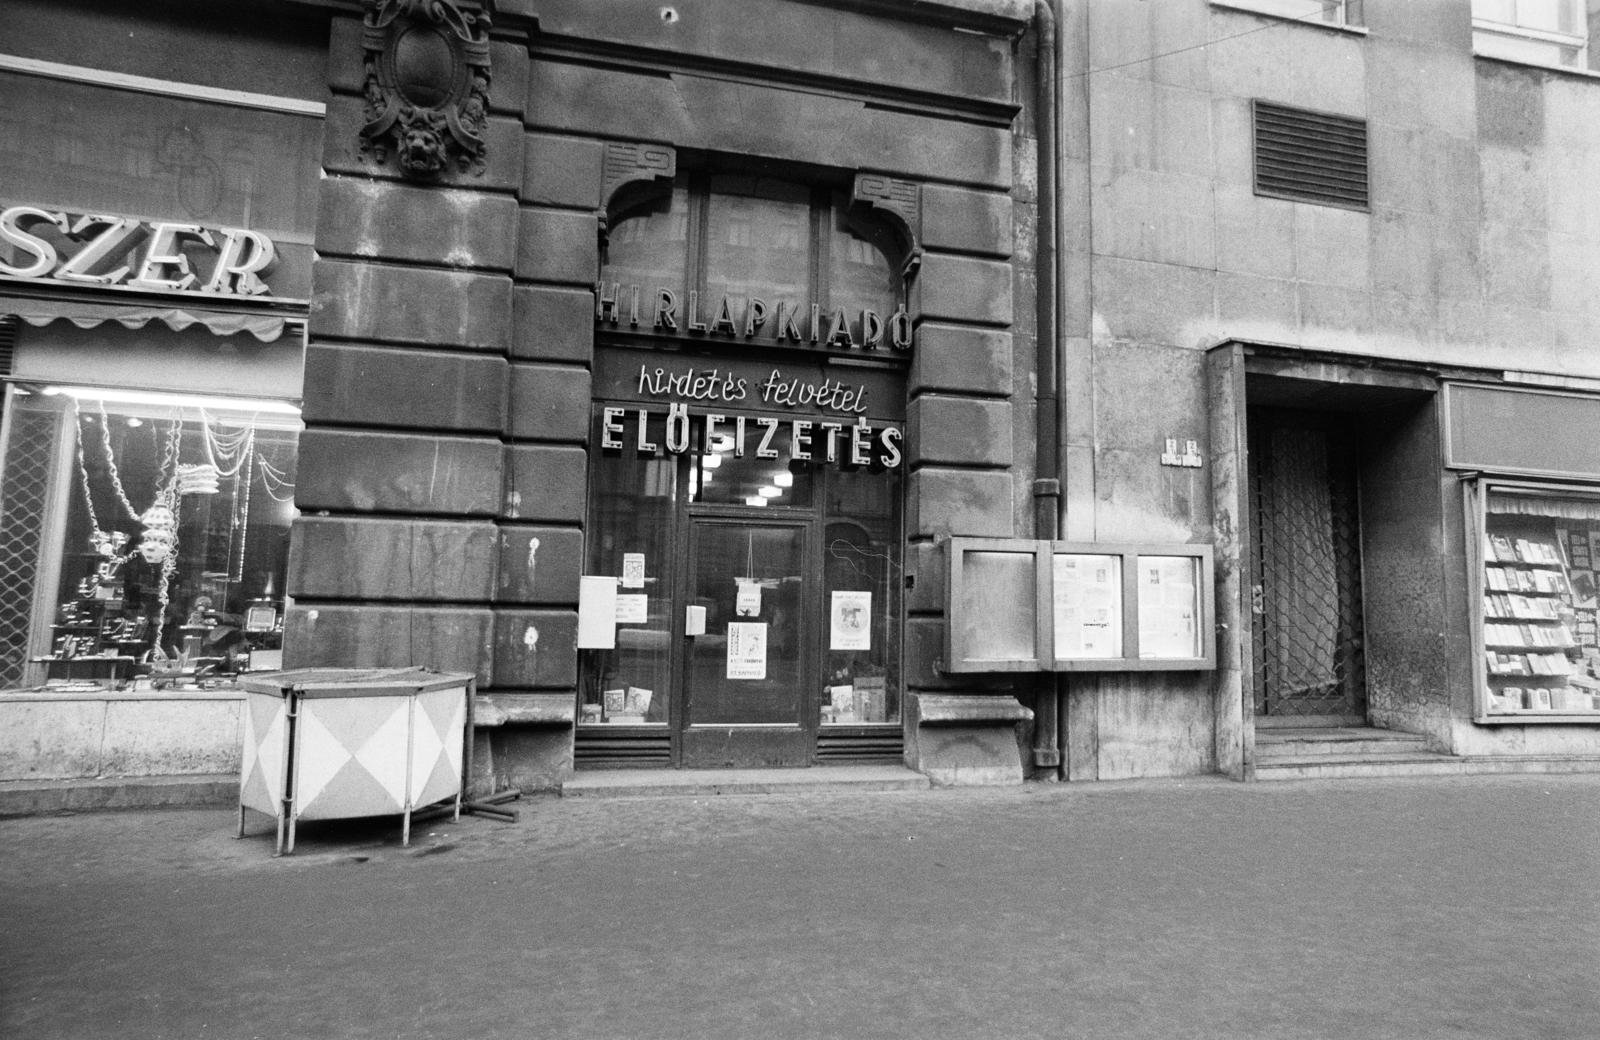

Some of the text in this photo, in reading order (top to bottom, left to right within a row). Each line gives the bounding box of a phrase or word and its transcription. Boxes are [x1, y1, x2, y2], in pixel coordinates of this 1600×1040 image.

[0, 206, 275, 296] SZER
[763, 368, 868, 414] felvétel
[601, 402, 903, 468] ELŐFIZETÉS
